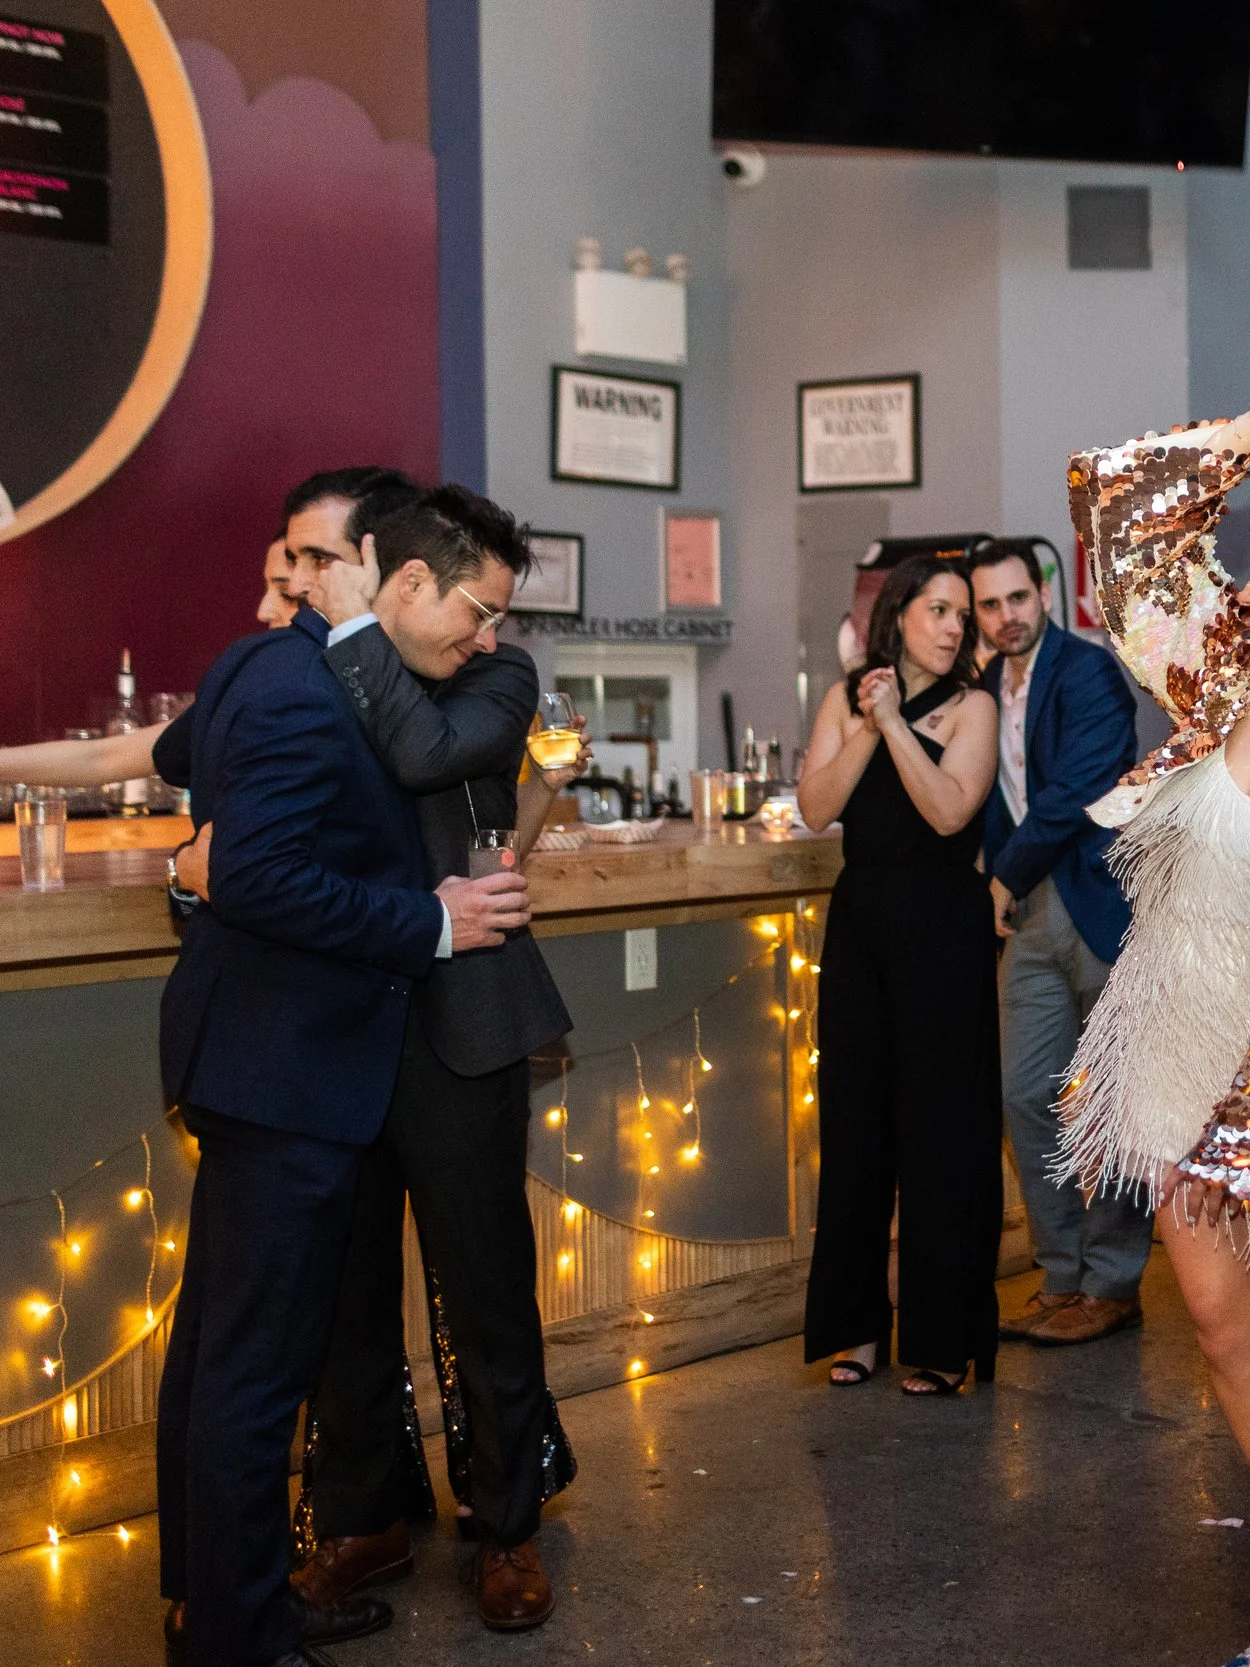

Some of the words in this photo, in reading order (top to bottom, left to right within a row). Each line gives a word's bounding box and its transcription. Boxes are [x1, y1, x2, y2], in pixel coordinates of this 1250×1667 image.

[574, 383, 662, 423] WARNING
[809, 392, 904, 419] GOVERNMENT
[823, 418, 890, 436] WARNING
[615, 617, 659, 636] HOSE
[664, 618, 732, 638] CABINET
